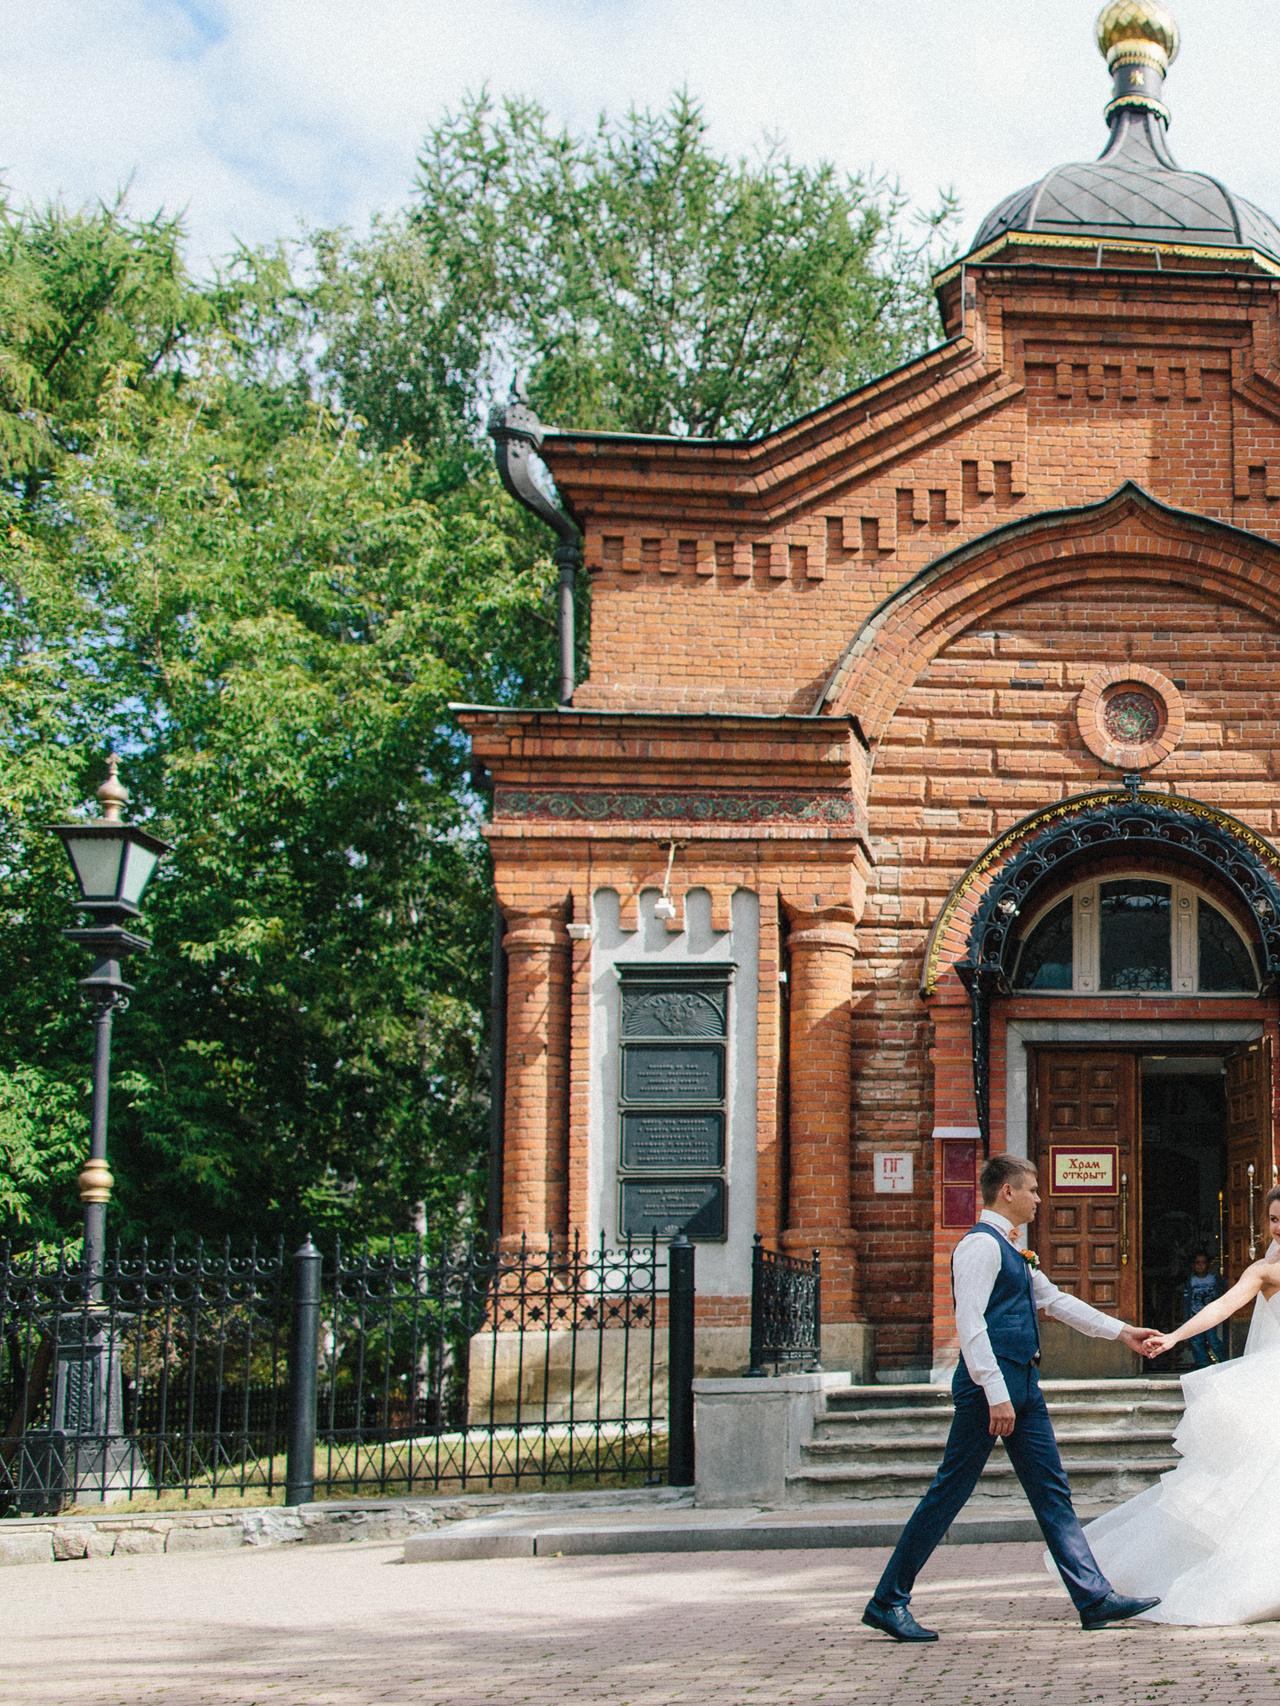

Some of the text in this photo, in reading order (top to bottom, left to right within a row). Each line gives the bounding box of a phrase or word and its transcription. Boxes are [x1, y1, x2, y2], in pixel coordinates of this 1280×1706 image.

[884, 1158, 903, 1173] ПГ
[1069, 1158, 1100, 1171] Храм
[1063, 1172, 1106, 1182] открыт
